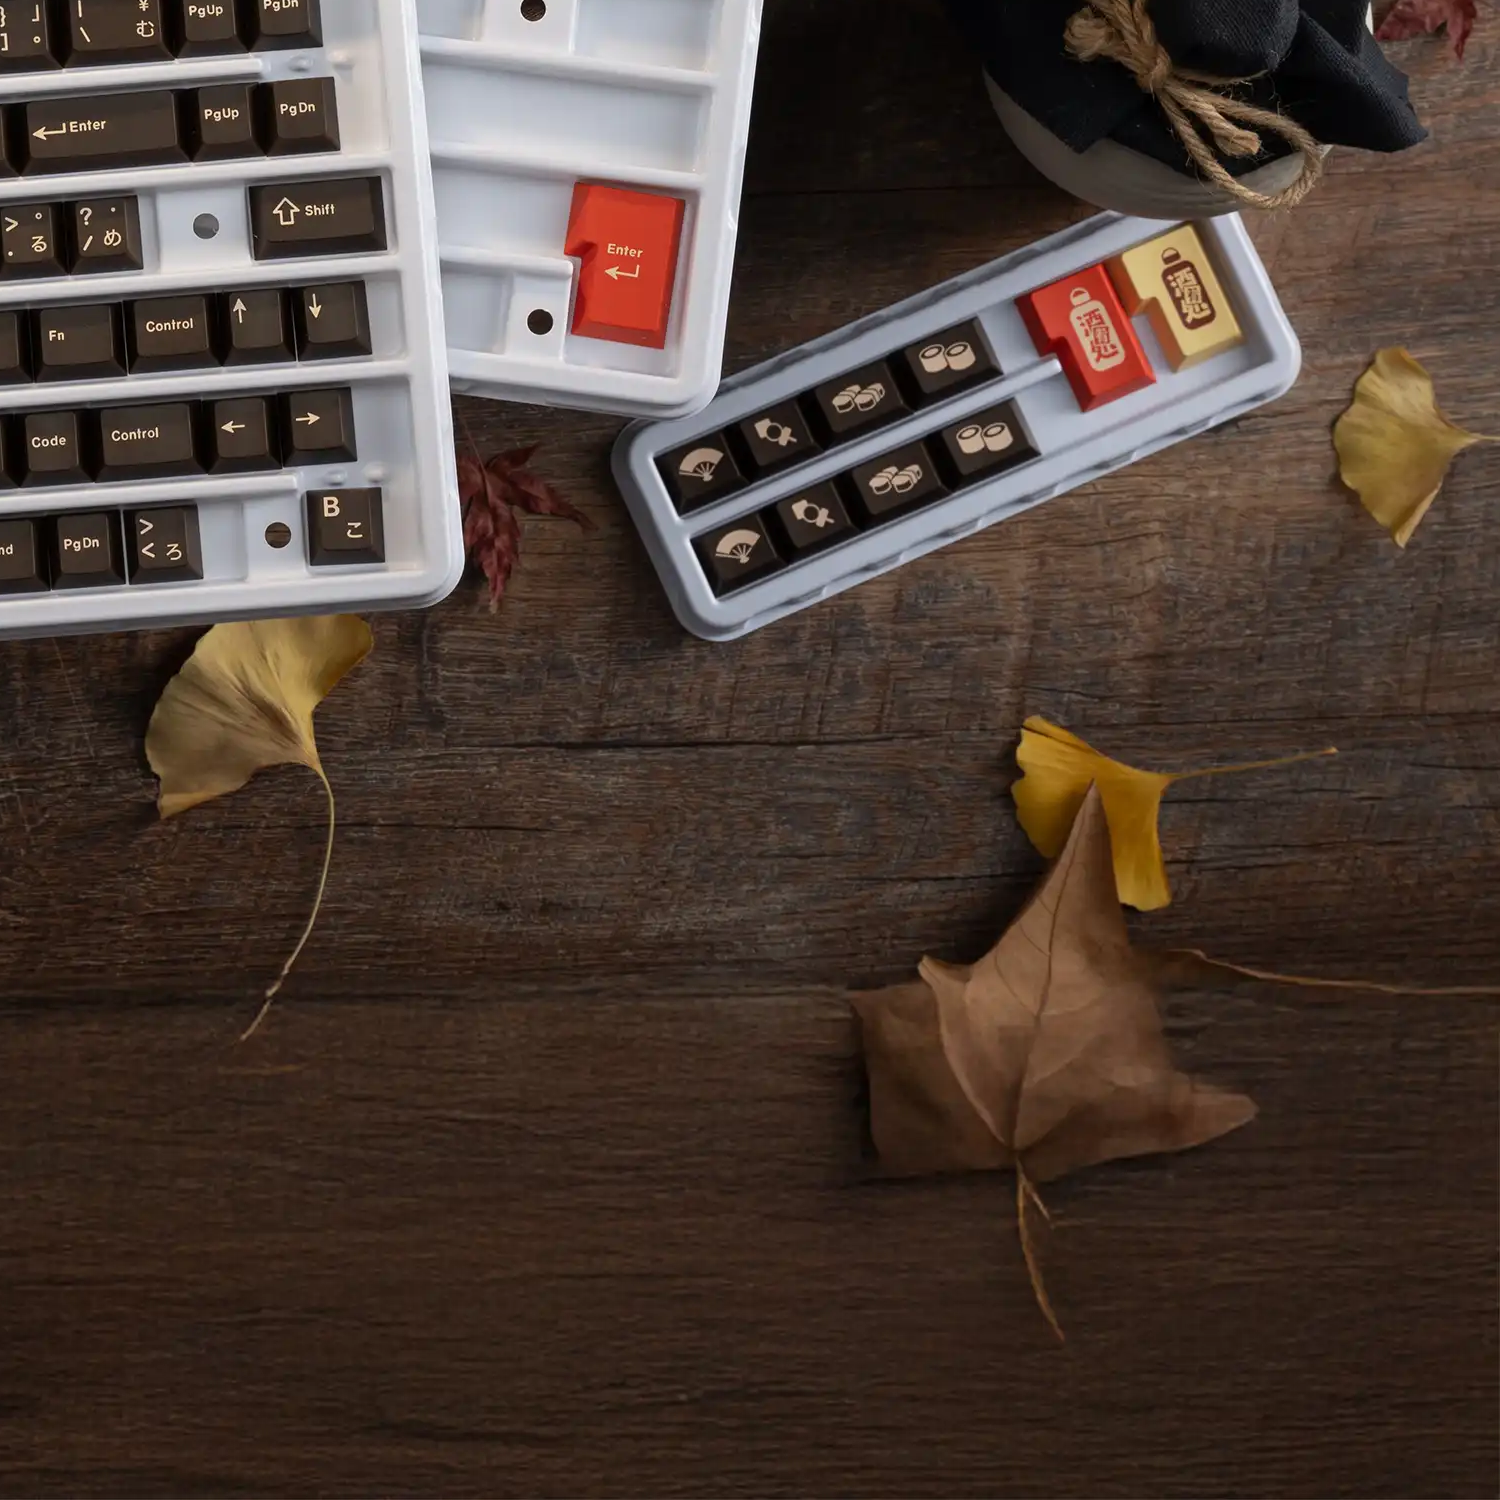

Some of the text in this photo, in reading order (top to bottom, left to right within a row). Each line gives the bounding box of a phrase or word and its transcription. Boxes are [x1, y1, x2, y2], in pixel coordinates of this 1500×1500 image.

[69, 120, 106, 132] Enter
[305, 204, 335, 216] Shift
[305, 204, 335, 216] Shift
[607, 243, 643, 258] Enter
[146, 318, 193, 332] Control
[49, 330, 64, 341] Fn
[111, 427, 159, 441] Control
[32, 435, 66, 448] Code
[323, 496, 340, 517] B
[347, 522, 363, 538] こ
